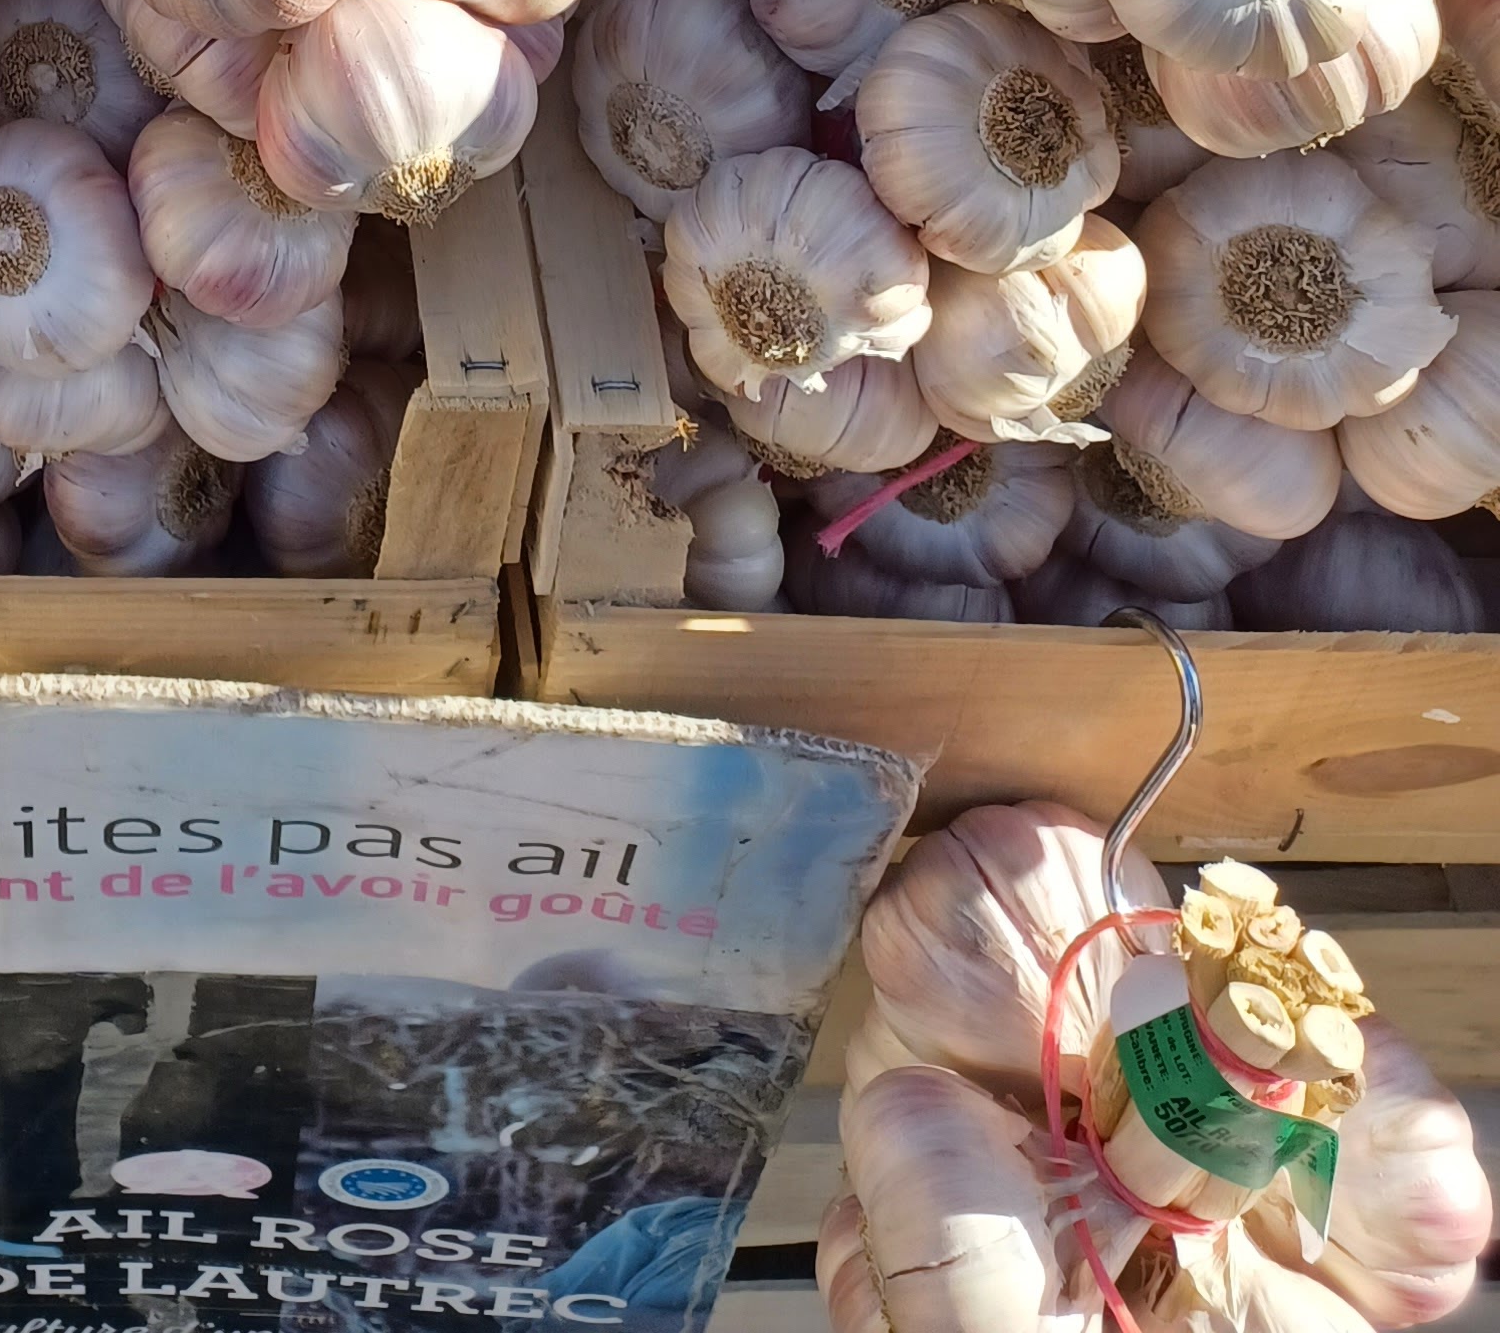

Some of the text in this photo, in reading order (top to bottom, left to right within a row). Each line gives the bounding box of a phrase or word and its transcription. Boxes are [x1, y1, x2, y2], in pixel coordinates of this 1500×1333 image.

[269, 817, 463, 870] pas
[506, 838, 638, 887] ail
[99, 864, 193, 899] de
[219, 863, 467, 909] l'avoir
[1127, 1028, 1155, 1093] Calibre:
[1166, 1035, 1178, 1052] de
[1173, 1053, 1193, 1085] LOT:
[1169, 1096, 1207, 1130] AIL
[32, 1208, 550, 1268] AIL ROSE
[117, 1260, 628, 1325] LAUTREC
